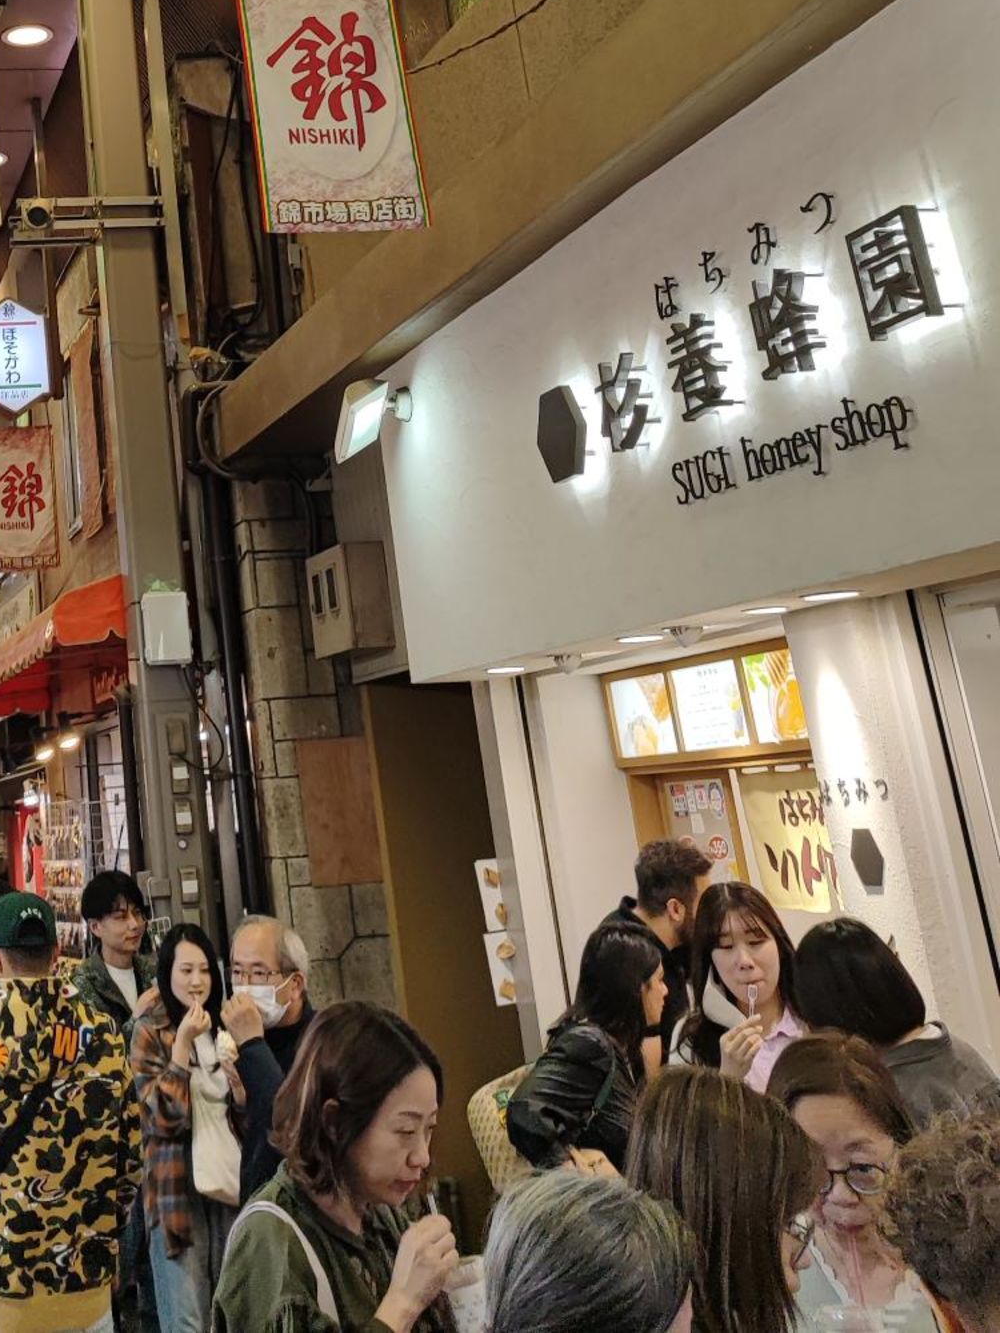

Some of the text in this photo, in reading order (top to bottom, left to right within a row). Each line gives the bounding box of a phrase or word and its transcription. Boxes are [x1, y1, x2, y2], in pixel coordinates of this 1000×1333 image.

[266, 11, 387, 152] 錦
[288, 128, 355, 145] NISHIKI
[277, 197, 416, 224] 錦市場商店街
[654, 192, 836, 320] はちみつ
[2, 327, 21, 384] ほそかわ
[595, 205, 945, 454] 杉養蜂園
[671, 395, 912, 505] SUGI honey shop
